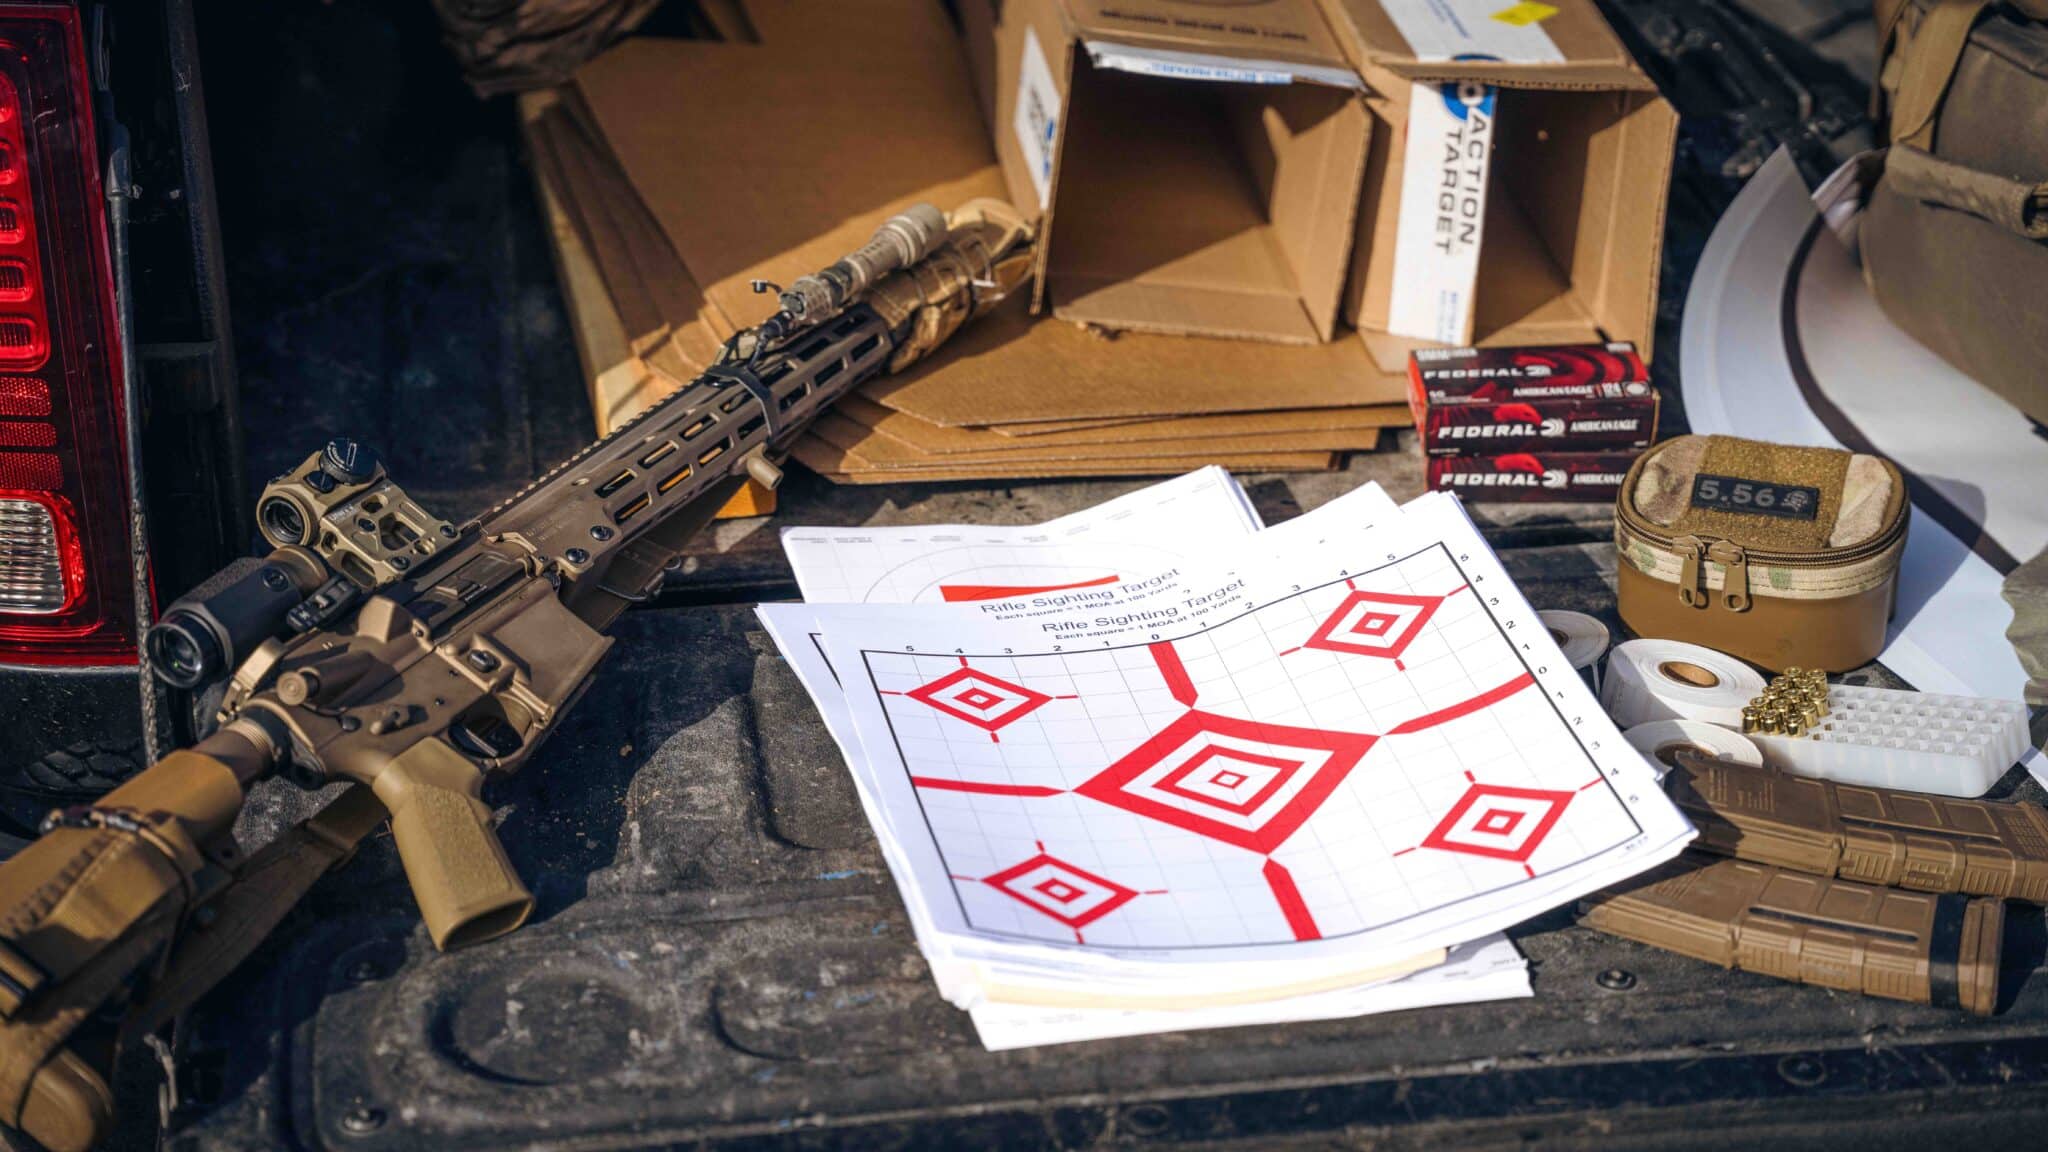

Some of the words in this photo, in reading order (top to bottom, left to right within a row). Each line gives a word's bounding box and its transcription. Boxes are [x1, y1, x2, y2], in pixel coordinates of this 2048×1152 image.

[1435, 127, 1463, 256] TARGET
[1460, 113, 1487, 246] ACTION
[1424, 368, 1523, 379] FEDERAL
[1438, 424, 1537, 439] FEDERAL
[1440, 473, 1539, 486] FEDERAL
[1698, 479, 1776, 508] 5.56
[980, 602, 1026, 614] Rifle
[1032, 590, 1115, 607] Sighting
[1121, 568, 1181, 593] Target
[995, 612, 1024, 620] Each
[1026, 608, 1064, 617] square
[1128, 594, 1146, 602] 100
[1148, 582, 1179, 596] Yards
[1245, 601, 1255, 610] 2
[1292, 584, 1301, 592] 3
[1339, 569, 1348, 577] 4
[1387, 553, 1396, 561] 5
[1042, 621, 1089, 633] Rifle
[1095, 607, 1179, 627] Sighting
[1182, 579, 1246, 608] Target
[1055, 632, 1084, 640] Each
[1087, 627, 1125, 637] square
[1147, 619, 1176, 628] MOA
[1191, 607, 1209, 617] 100
[1211, 594, 1242, 609] Yards
[1460, 553, 1469, 562] 5
[1475, 574, 1484, 583] 4
[1489, 597, 1500, 606] 3
[1506, 620, 1517, 629] 2
[1522, 643, 1531, 651] 1
[1538, 666, 1548, 674] 0
[1556, 691, 1565, 699] 1
[1573, 716, 1583, 725] 2
[1591, 741, 1601, 750] 3
[1610, 768, 1620, 776] 4
